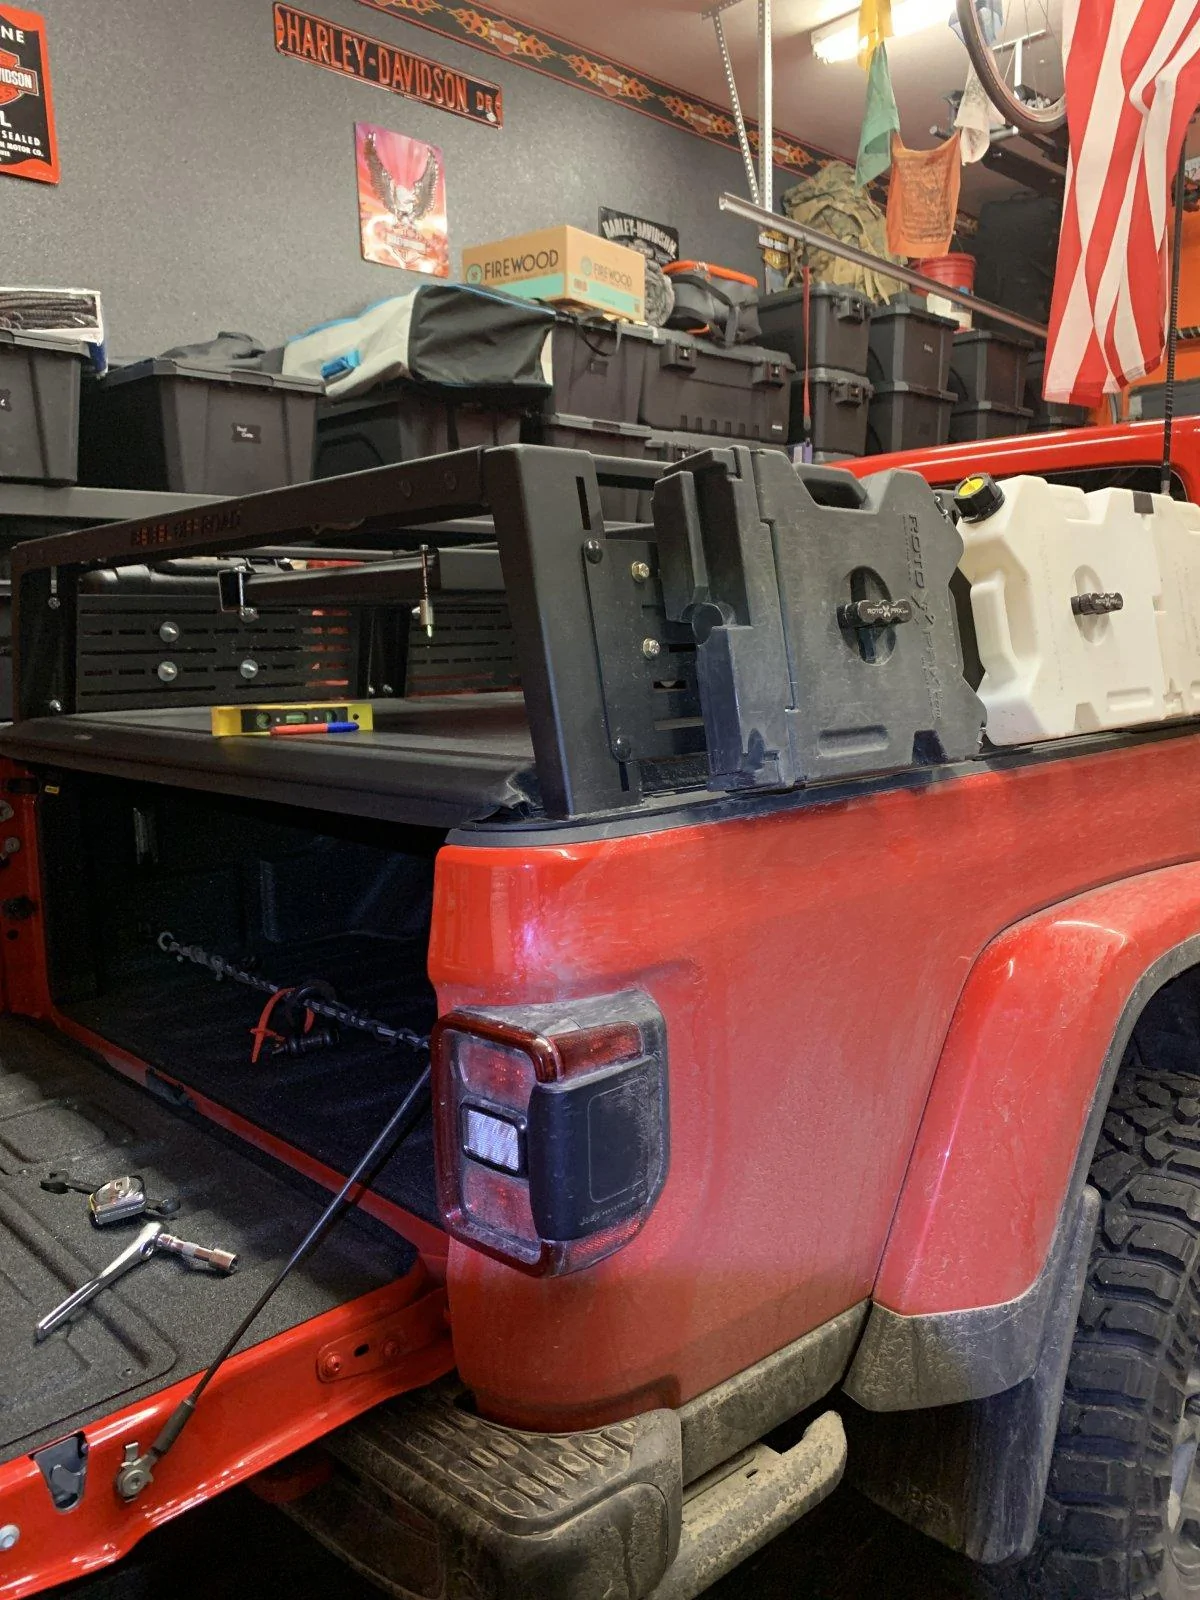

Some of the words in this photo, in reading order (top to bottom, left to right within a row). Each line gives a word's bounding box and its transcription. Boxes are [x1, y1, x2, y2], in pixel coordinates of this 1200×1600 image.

[286, 12, 470, 114] HARLEY-DAVIDSON
[1, 129, 41, 147] SEALED
[6, 142, 31, 155] MOTOR
[484, 248, 560, 281] FIREWOOD
[593, 261, 633, 289] FIREWOOD
[908, 513, 925, 590] ROTO
[867, 607, 884, 615] ROTO
